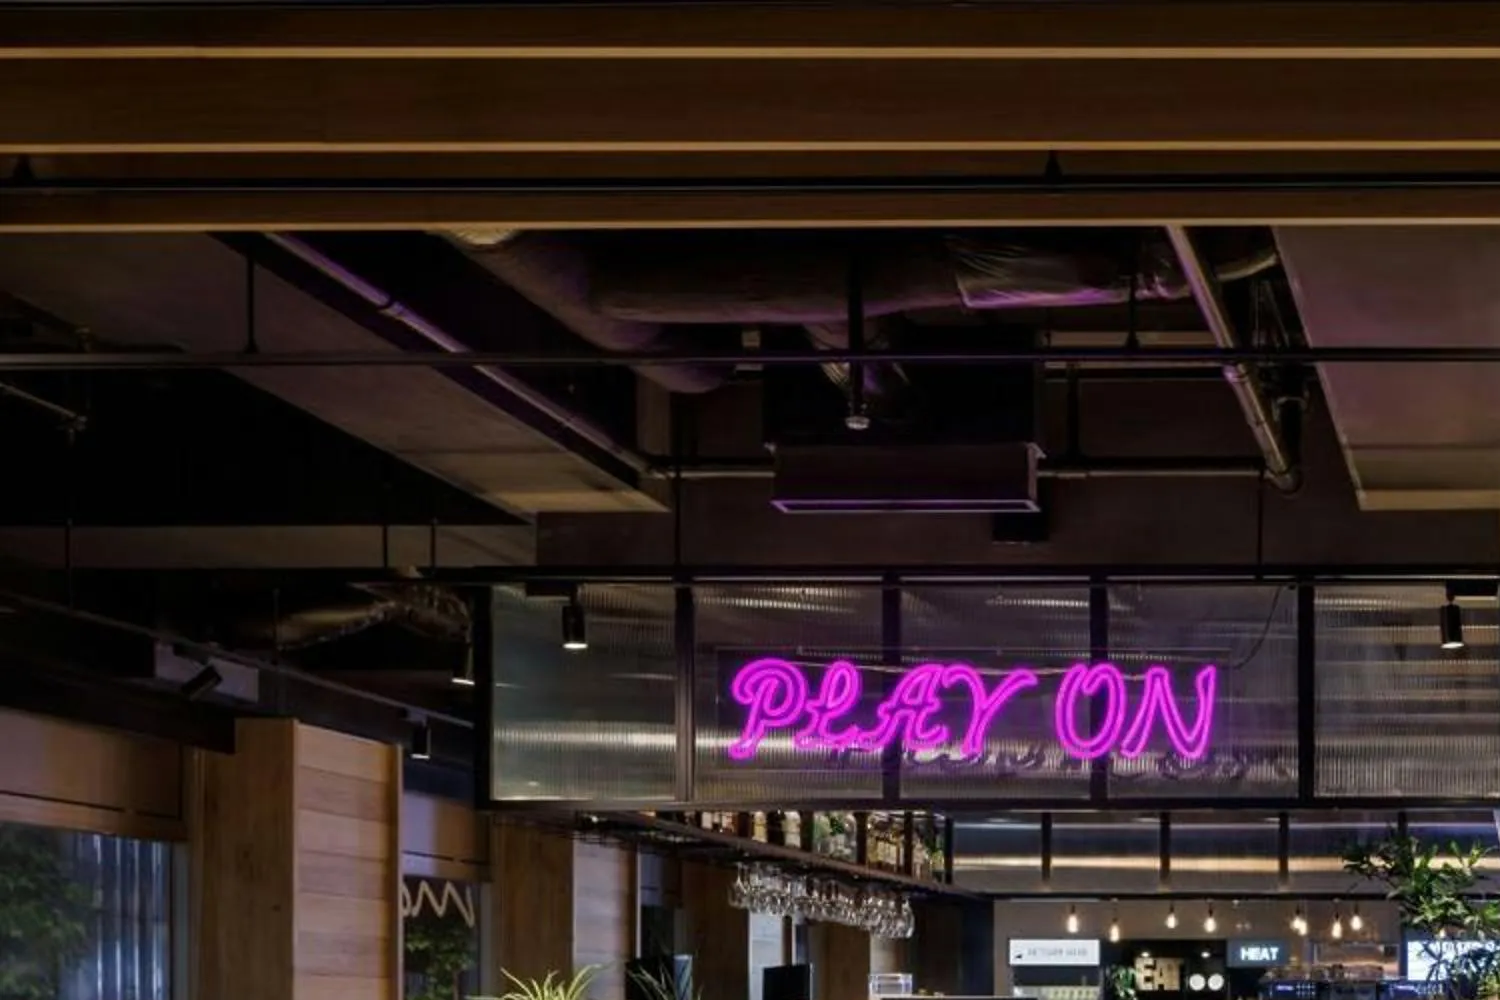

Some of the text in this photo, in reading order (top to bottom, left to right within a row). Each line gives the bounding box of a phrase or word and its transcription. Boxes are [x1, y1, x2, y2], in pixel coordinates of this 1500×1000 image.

[729, 658, 1216, 760] PLAY ON
[1240, 946, 1280, 961] HEAT
